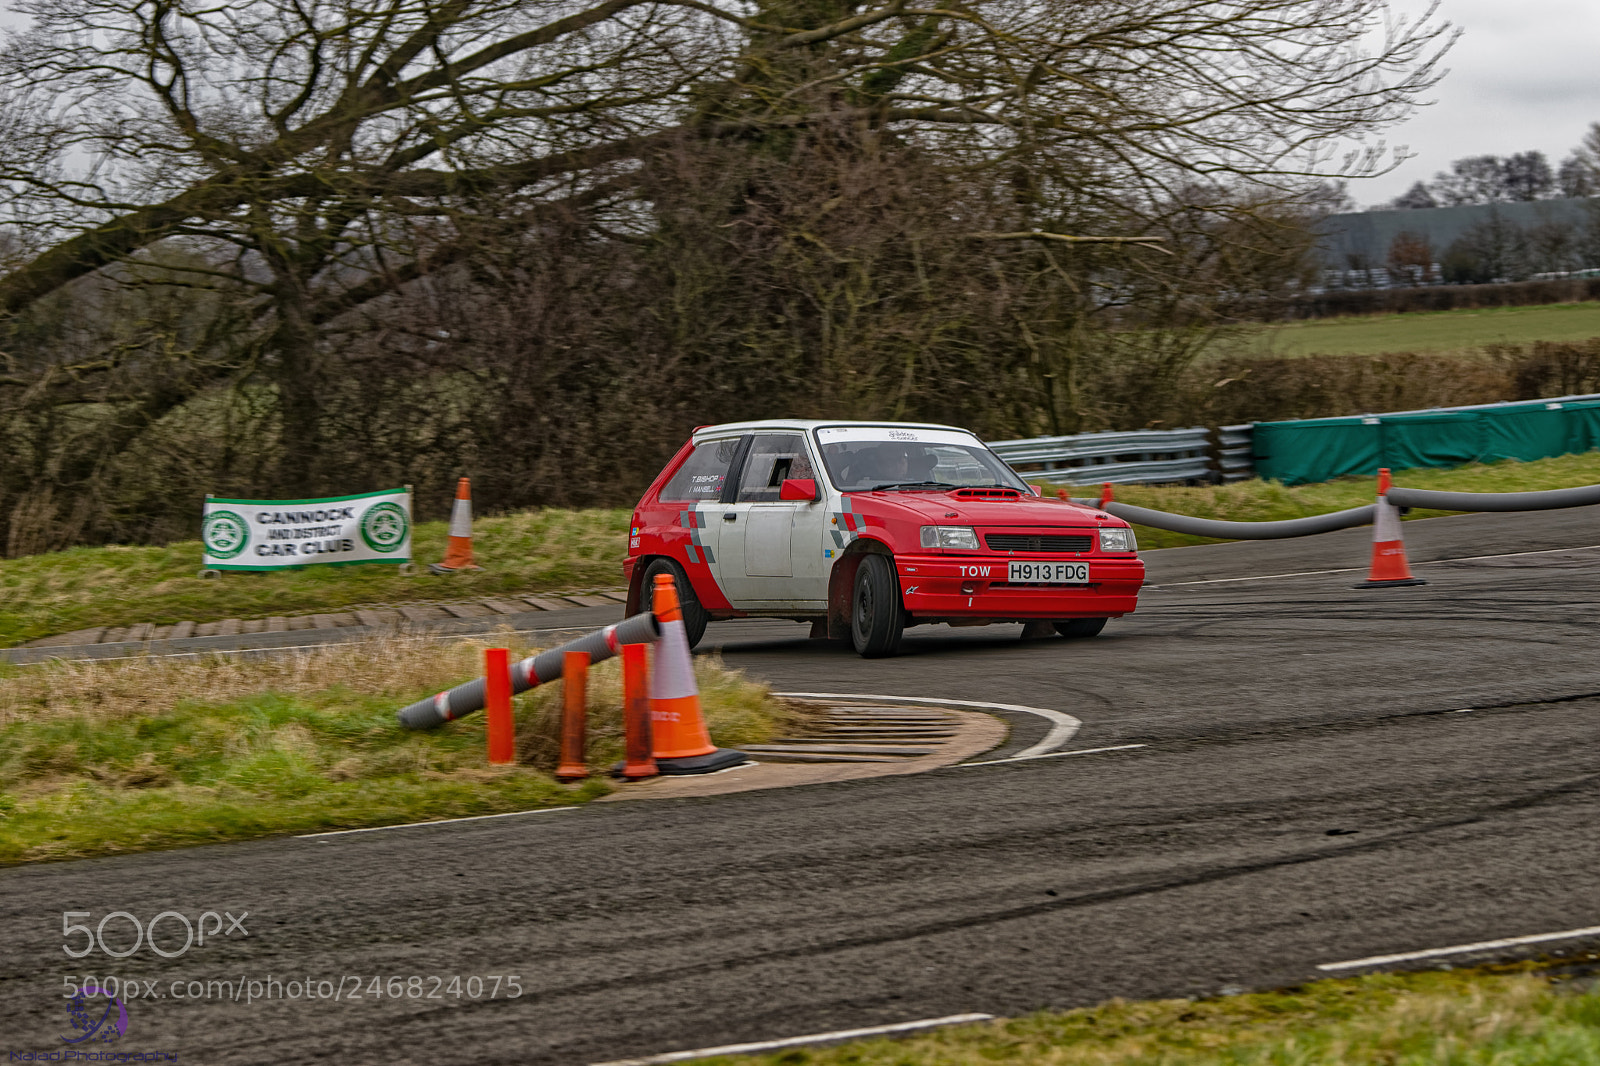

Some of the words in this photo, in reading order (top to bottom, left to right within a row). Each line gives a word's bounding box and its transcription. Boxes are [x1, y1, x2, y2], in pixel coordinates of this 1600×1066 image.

[257, 507, 355, 525] CANNOCK
[266, 527, 292, 540] AND
[293, 525, 343, 539] DISTRICT
[255, 543, 298, 557] CAR
[302, 539, 355, 554] CLUB
[959, 566, 991, 577] TOW
[1010, 565, 1051, 580] H913
[1055, 566, 1087, 580] FDG
